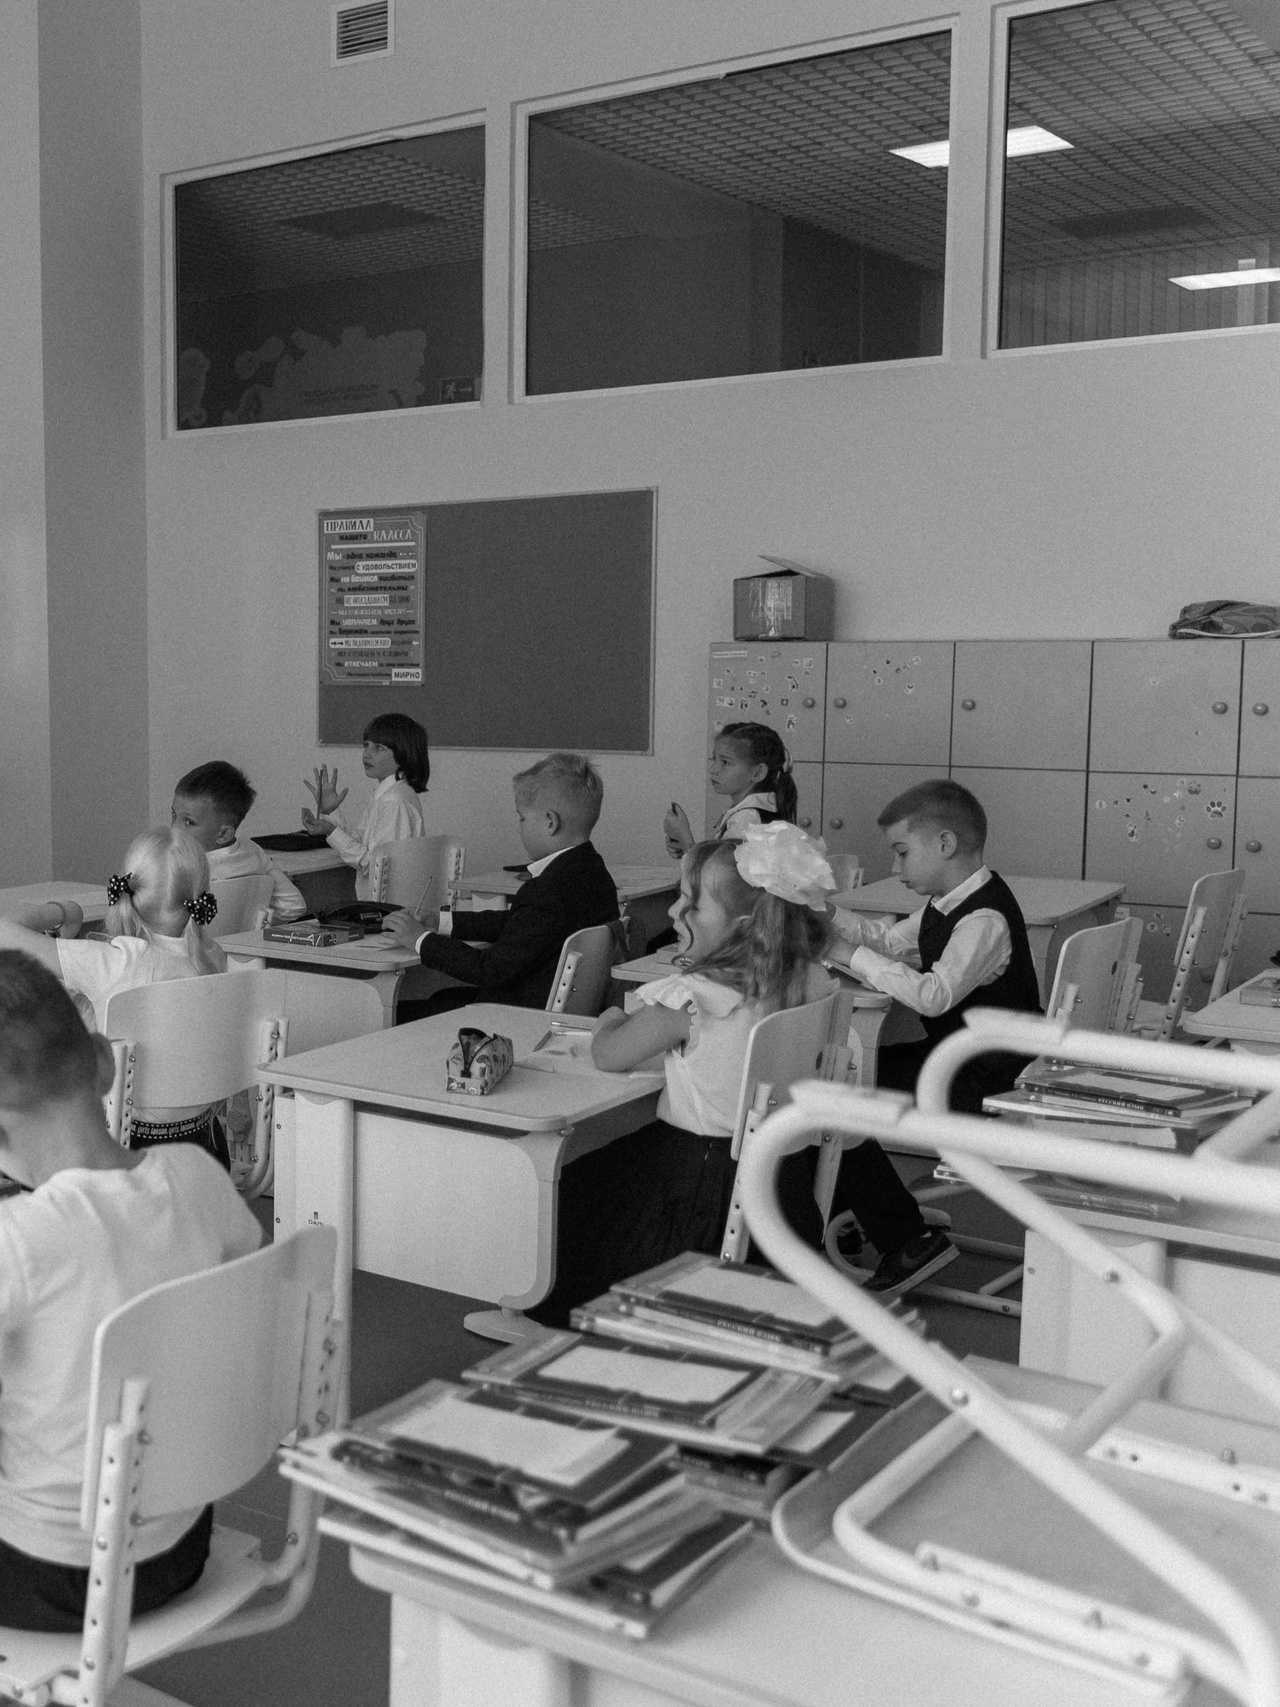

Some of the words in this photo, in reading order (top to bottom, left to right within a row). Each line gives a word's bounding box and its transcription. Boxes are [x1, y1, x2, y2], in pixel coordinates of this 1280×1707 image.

[325, 520, 372, 531] ПРАВИЛА
[373, 529, 412, 541] КЛАССА
[327, 552, 342, 561] Мы
[362, 562, 417, 571] УДОВОЛЬСТВИЕМ
[394, 672, 420, 680] МИРНО
